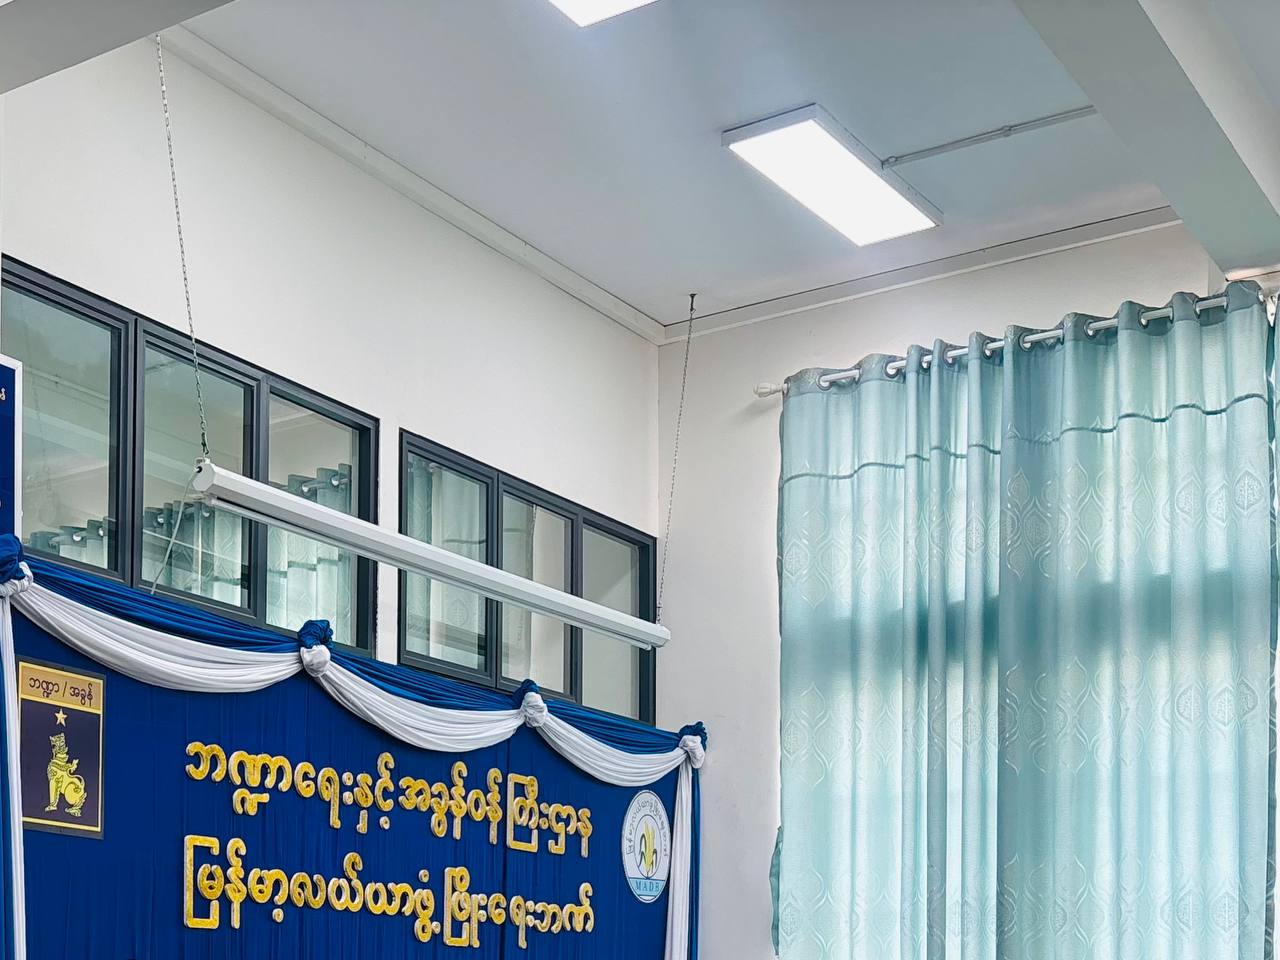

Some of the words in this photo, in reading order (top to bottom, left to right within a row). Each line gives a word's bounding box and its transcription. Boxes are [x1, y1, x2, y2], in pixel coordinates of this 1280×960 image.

[28, 677, 60, 698] ဘဏ္ဍာ
[69, 682, 94, 707] အခွန်
[634, 879, 661, 893] MADB
